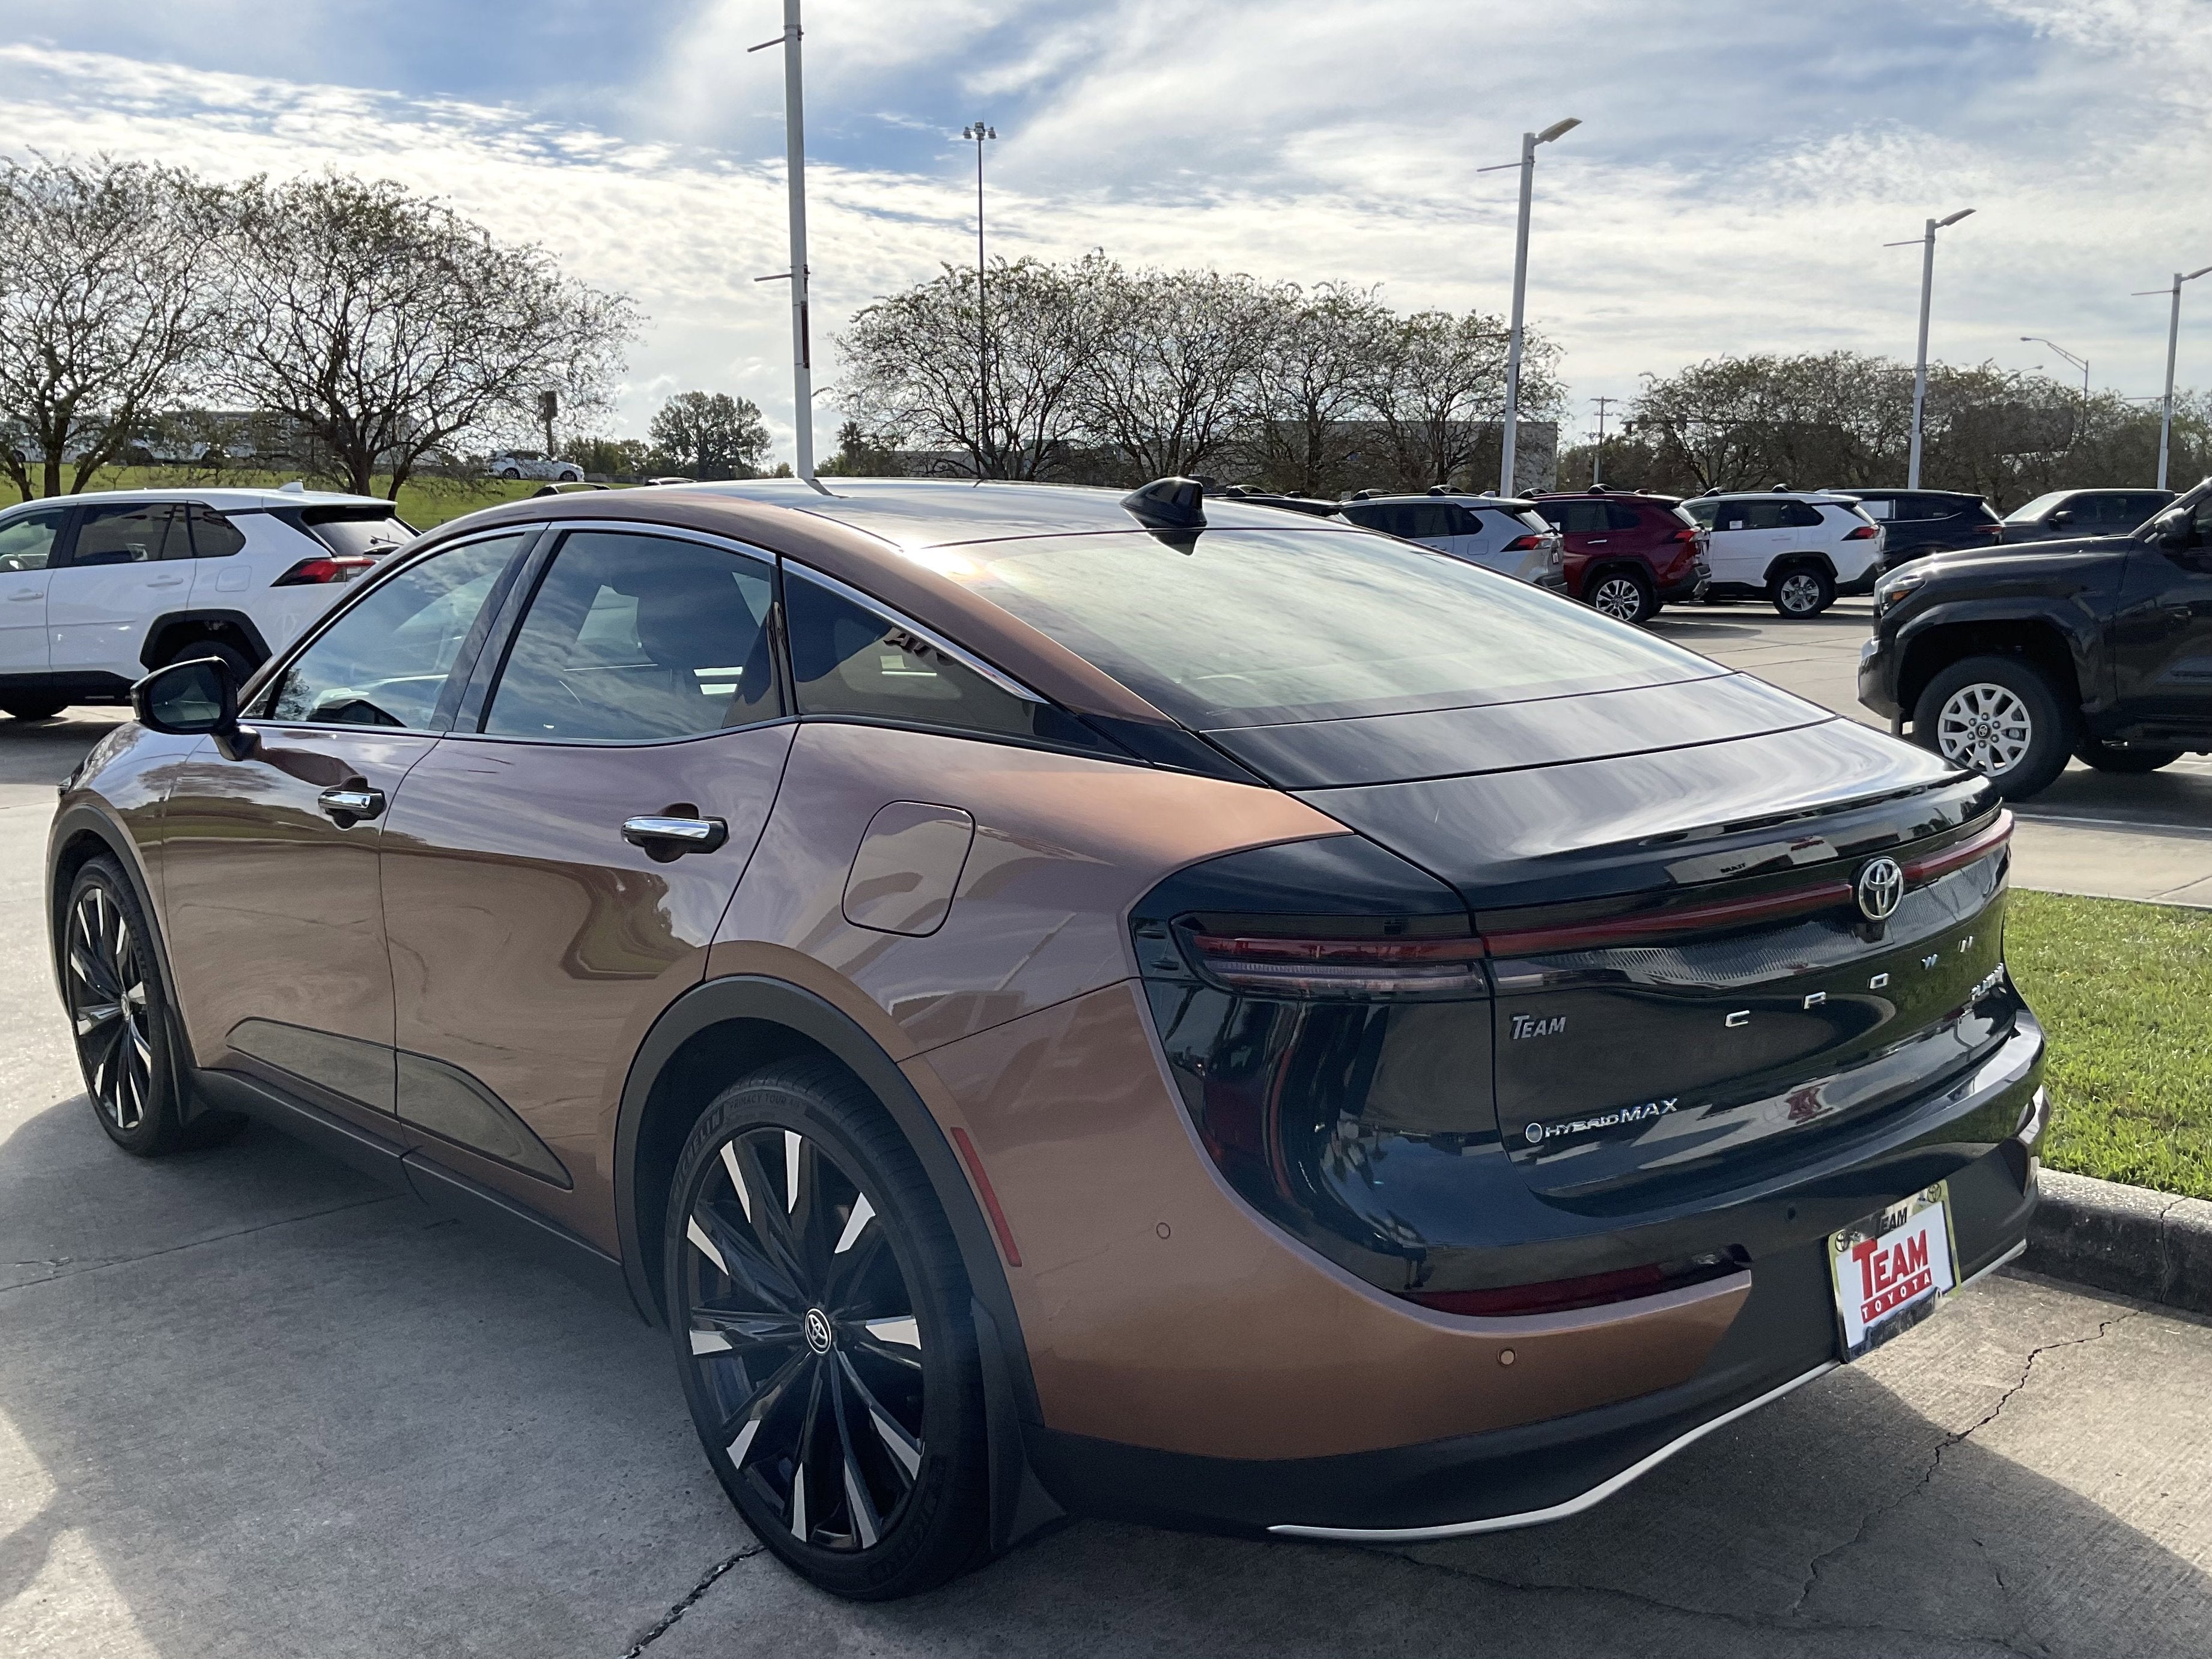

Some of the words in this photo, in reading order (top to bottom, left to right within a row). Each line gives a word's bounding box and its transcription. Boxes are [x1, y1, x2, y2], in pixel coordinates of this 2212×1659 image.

[1512, 1015, 1566, 1040] TEAM
[1852, 1229, 1928, 1301] TEAM
[1862, 1272, 1931, 1320] TOYOTA
